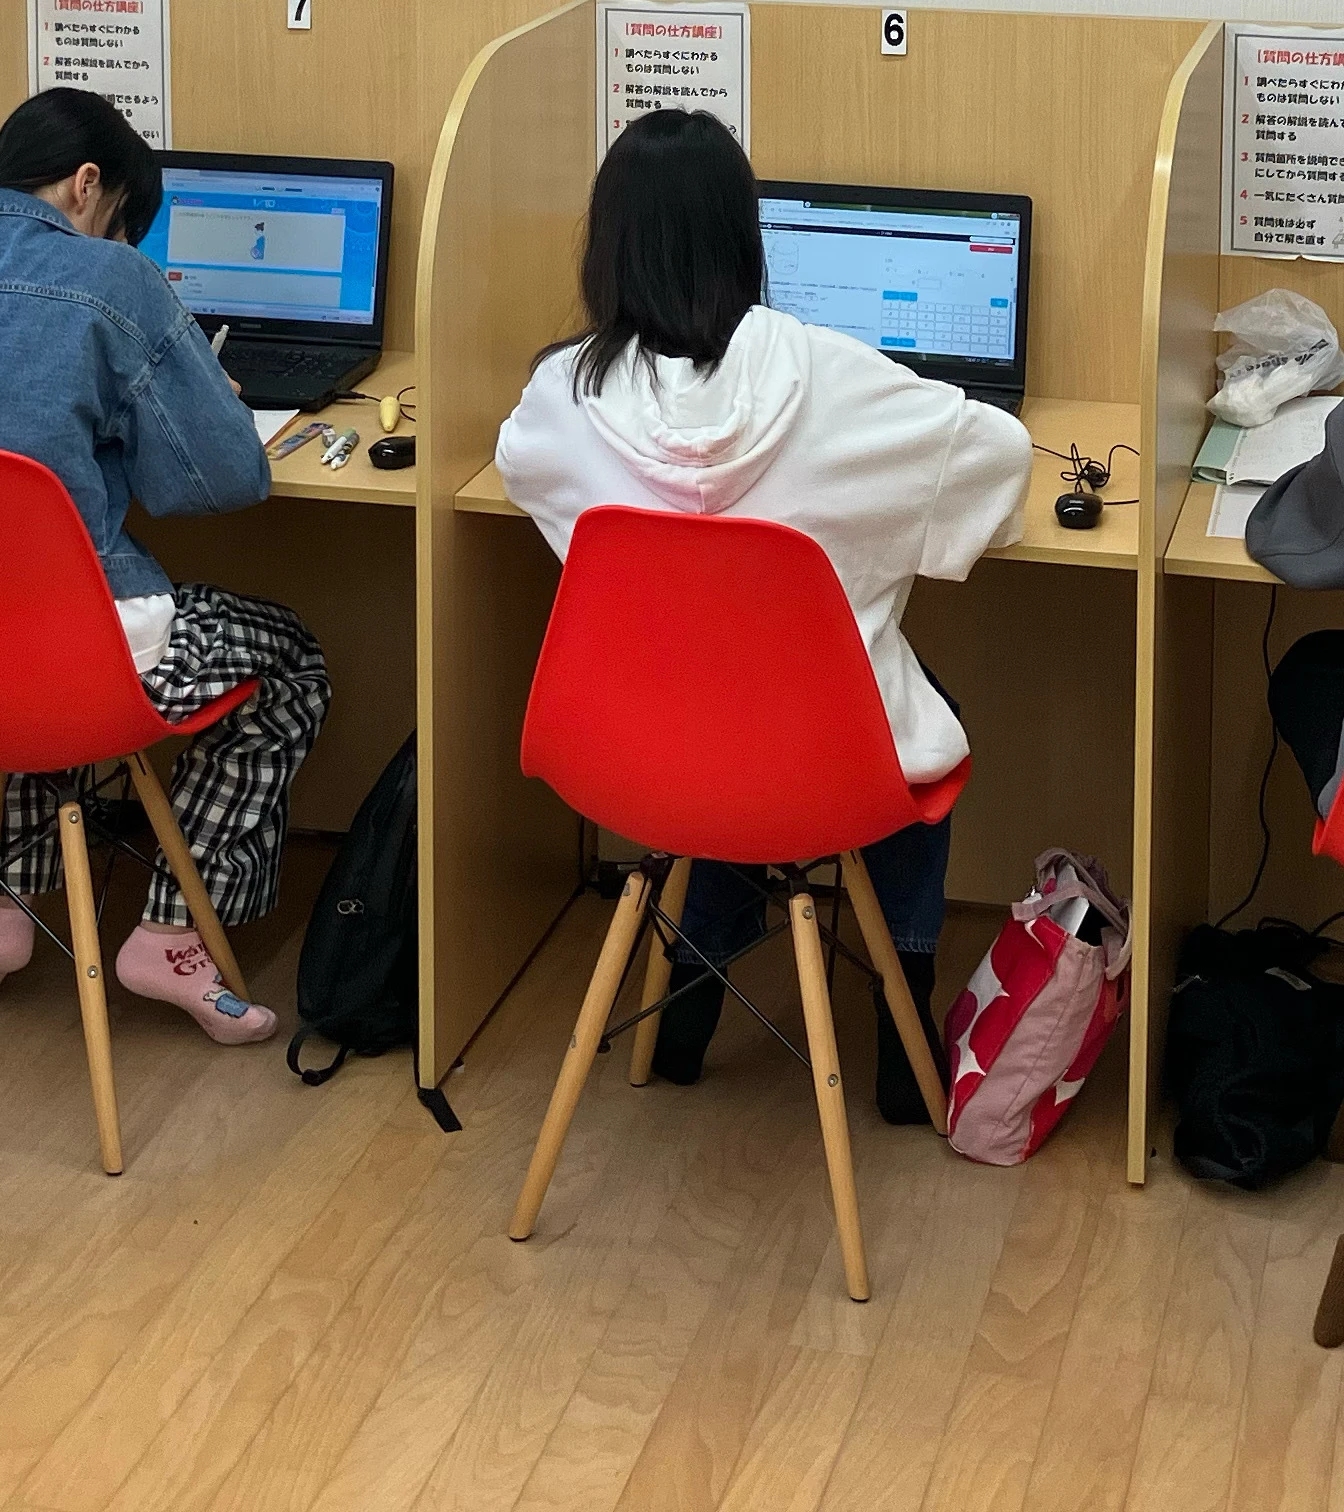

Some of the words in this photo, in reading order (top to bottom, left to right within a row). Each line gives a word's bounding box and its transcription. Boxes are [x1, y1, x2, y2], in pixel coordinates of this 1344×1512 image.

[55, 22, 140, 35] 調べたらすぐにわかる
[884, 13, 904, 46] 6
[55, 37, 123, 48] ものは質問しない
[625, 48, 718, 62] 調べたらすぐにわかる
[54, 57, 150, 70] 解答の解説を読んでから
[626, 64, 700, 75] ものは質問しない
[55, 71, 89, 81] 質問する
[625, 84, 728, 97] 解答の解説を読んでから
[107, 94, 159, 105] できるよう
[625, 99, 662, 109] 質問する
[1257, 93, 1340, 105] ものは質問しない
[1255, 130, 1297, 142] 質問する
[1254, 216, 1316, 230] 質問後は必ず
[1254, 232, 1326, 246] 自分で解き直す
